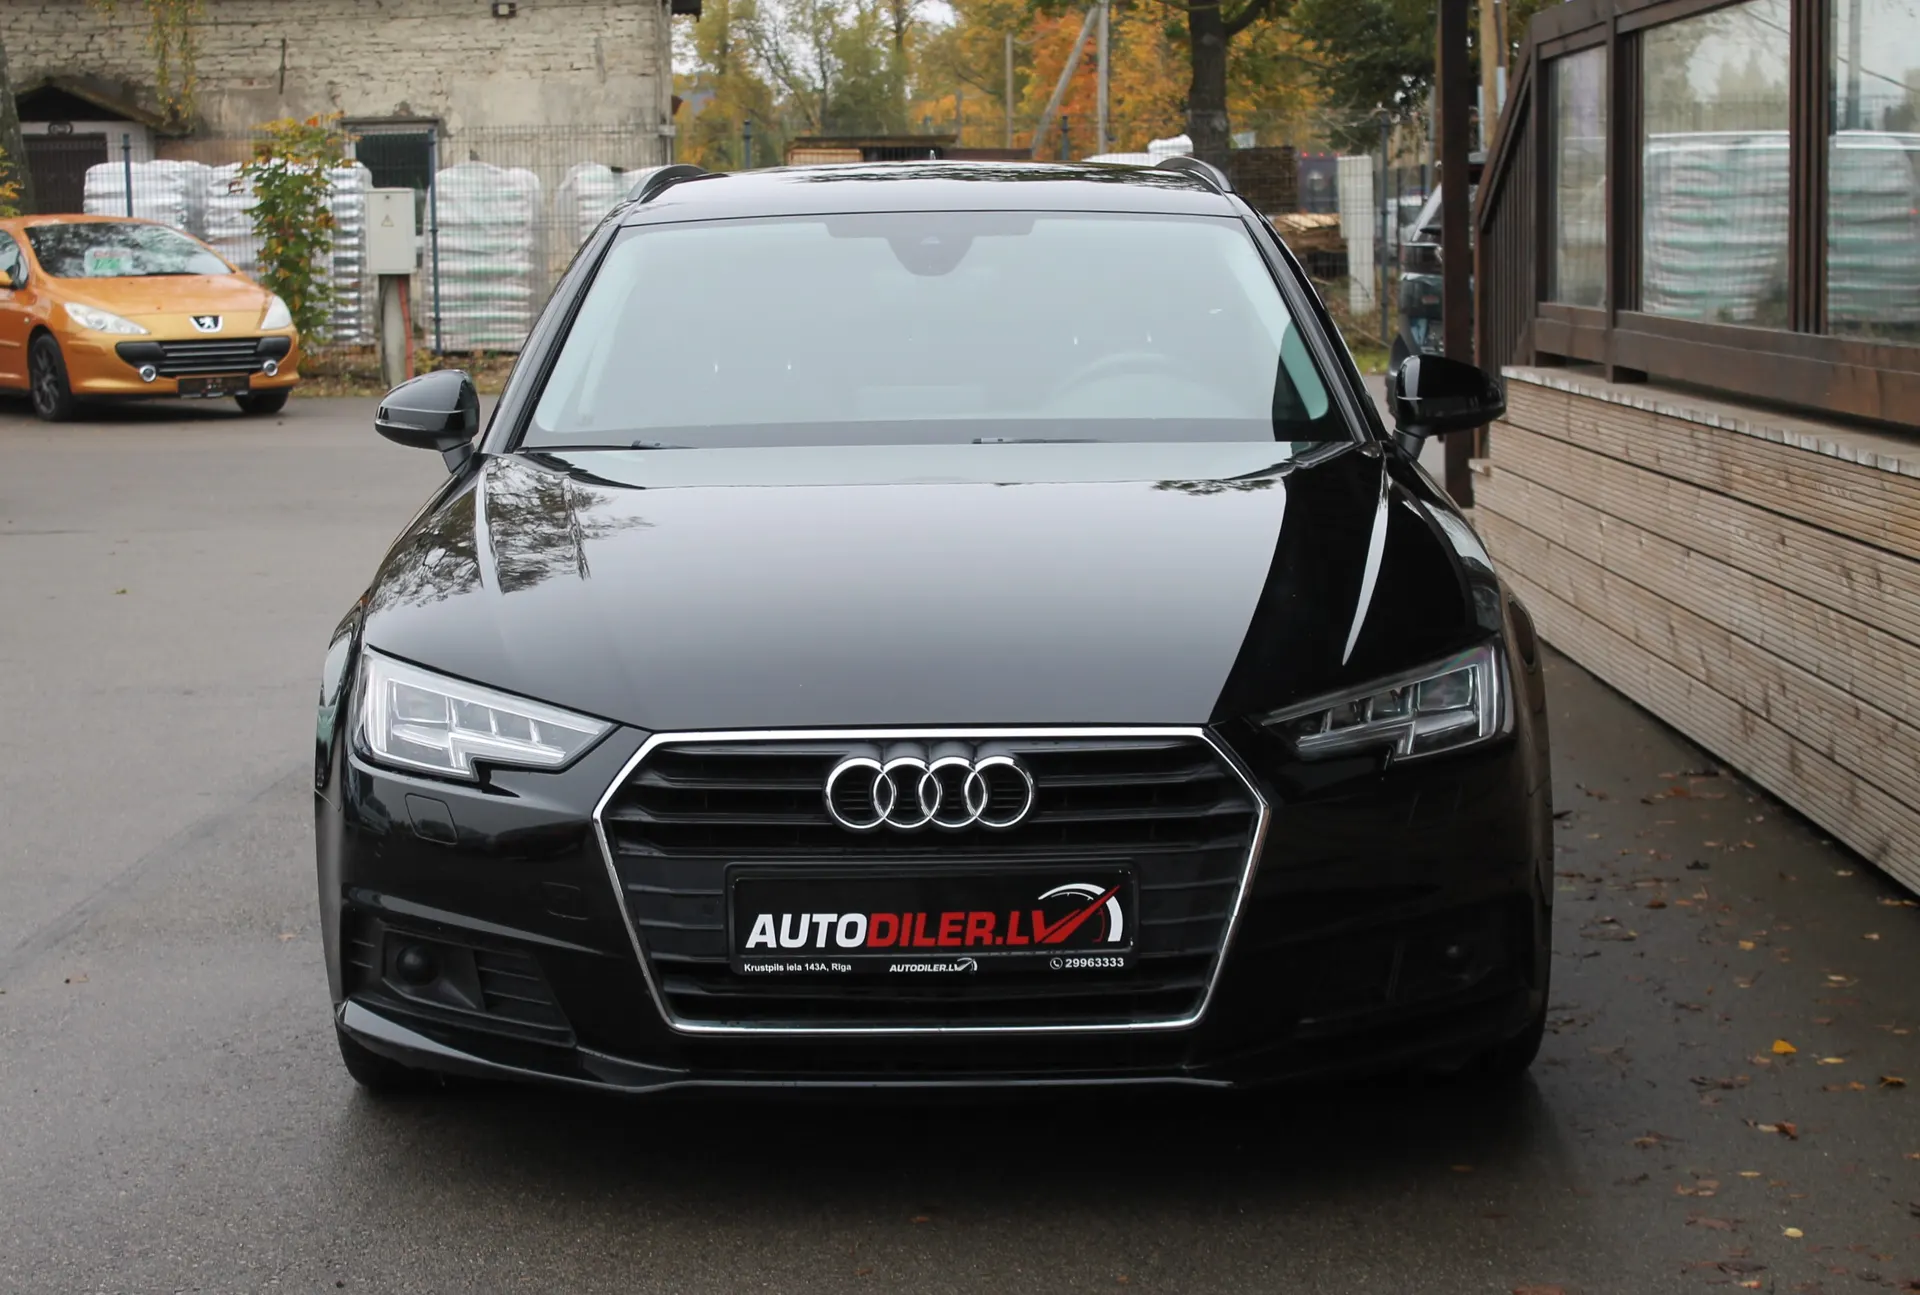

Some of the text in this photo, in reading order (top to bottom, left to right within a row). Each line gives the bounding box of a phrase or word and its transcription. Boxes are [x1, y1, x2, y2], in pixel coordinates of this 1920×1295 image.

[745, 907, 1092, 949] AUTODILER.LV
[744, 963, 784, 973] Krustpils
[786, 963, 803, 972] iela
[804, 963, 829, 972] 143A,
[889, 961, 970, 972] AUTODILER.LV
[1065, 957, 1124, 968] 29963333
